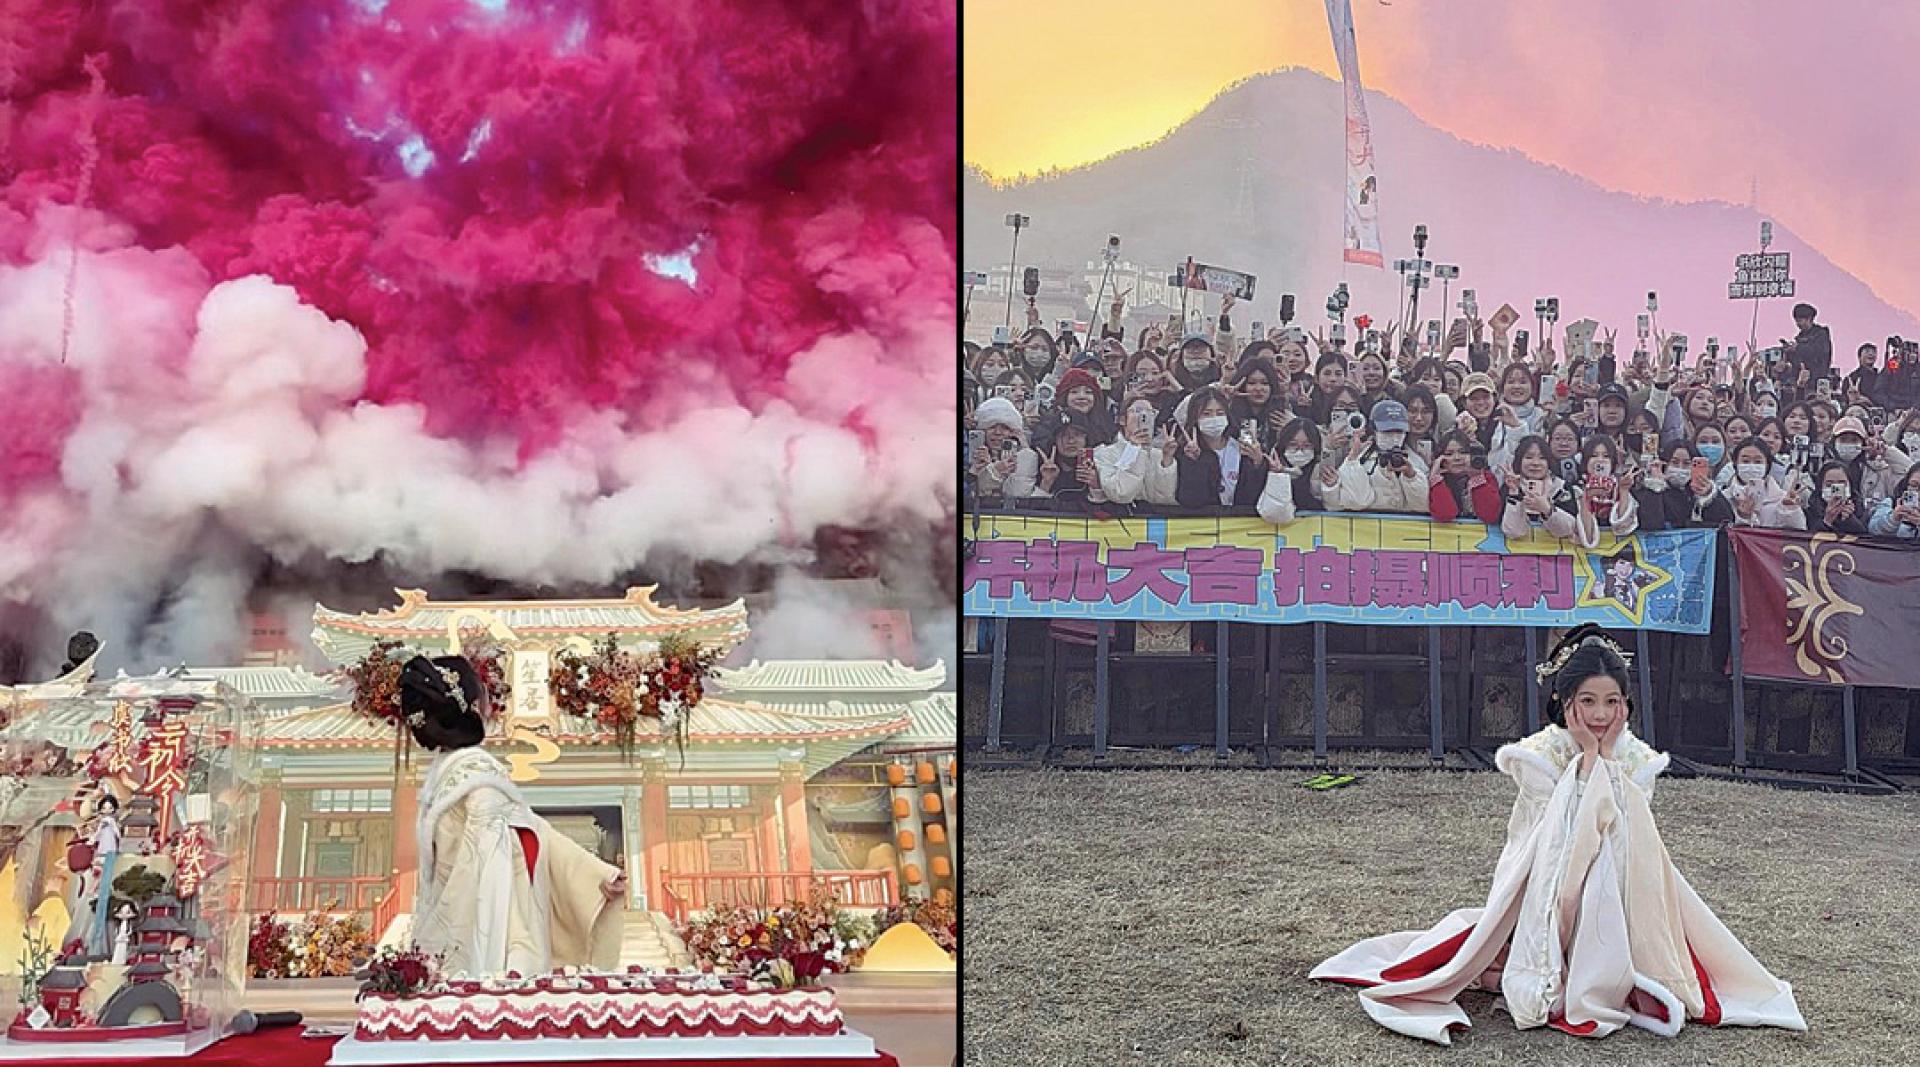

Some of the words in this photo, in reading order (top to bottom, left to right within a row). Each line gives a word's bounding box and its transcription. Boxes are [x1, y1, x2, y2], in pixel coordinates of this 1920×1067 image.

[963, 539, 1264, 605] 开机大吉
[1273, 545, 1576, 612] 拍摄顺利
